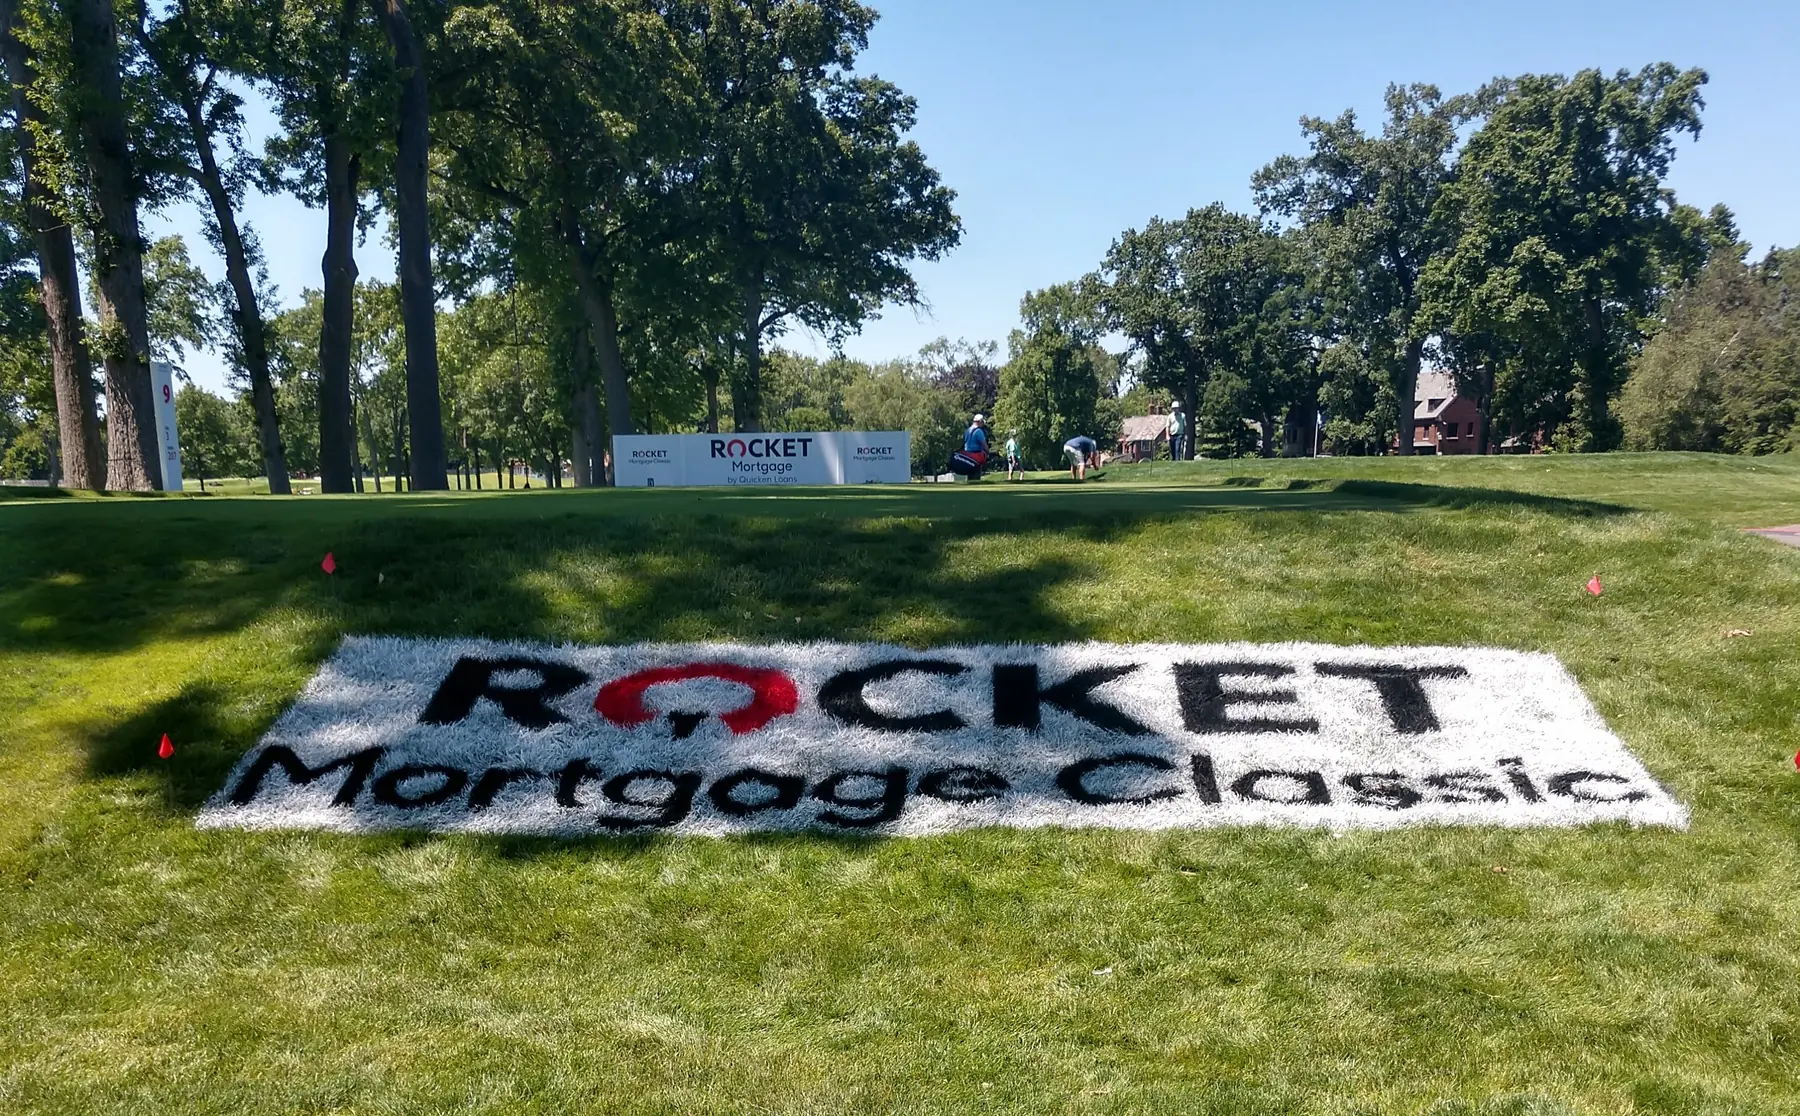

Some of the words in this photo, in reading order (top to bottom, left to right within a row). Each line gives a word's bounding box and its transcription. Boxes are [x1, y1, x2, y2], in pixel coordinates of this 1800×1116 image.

[163, 384, 170, 404] 9
[632, 450, 668, 458] ROCKET
[711, 438, 812, 458] ROCKET
[857, 447, 892, 455] ROCKET
[732, 460, 793, 475] Mortgage
[728, 476, 737, 486] by
[739, 476, 772, 484] Quicken
[774, 475, 798, 484] Loans
[417, 655, 1468, 738] ROCKET
[228, 743, 1006, 828] Mortgage
[1055, 751, 1650, 809] Classic
